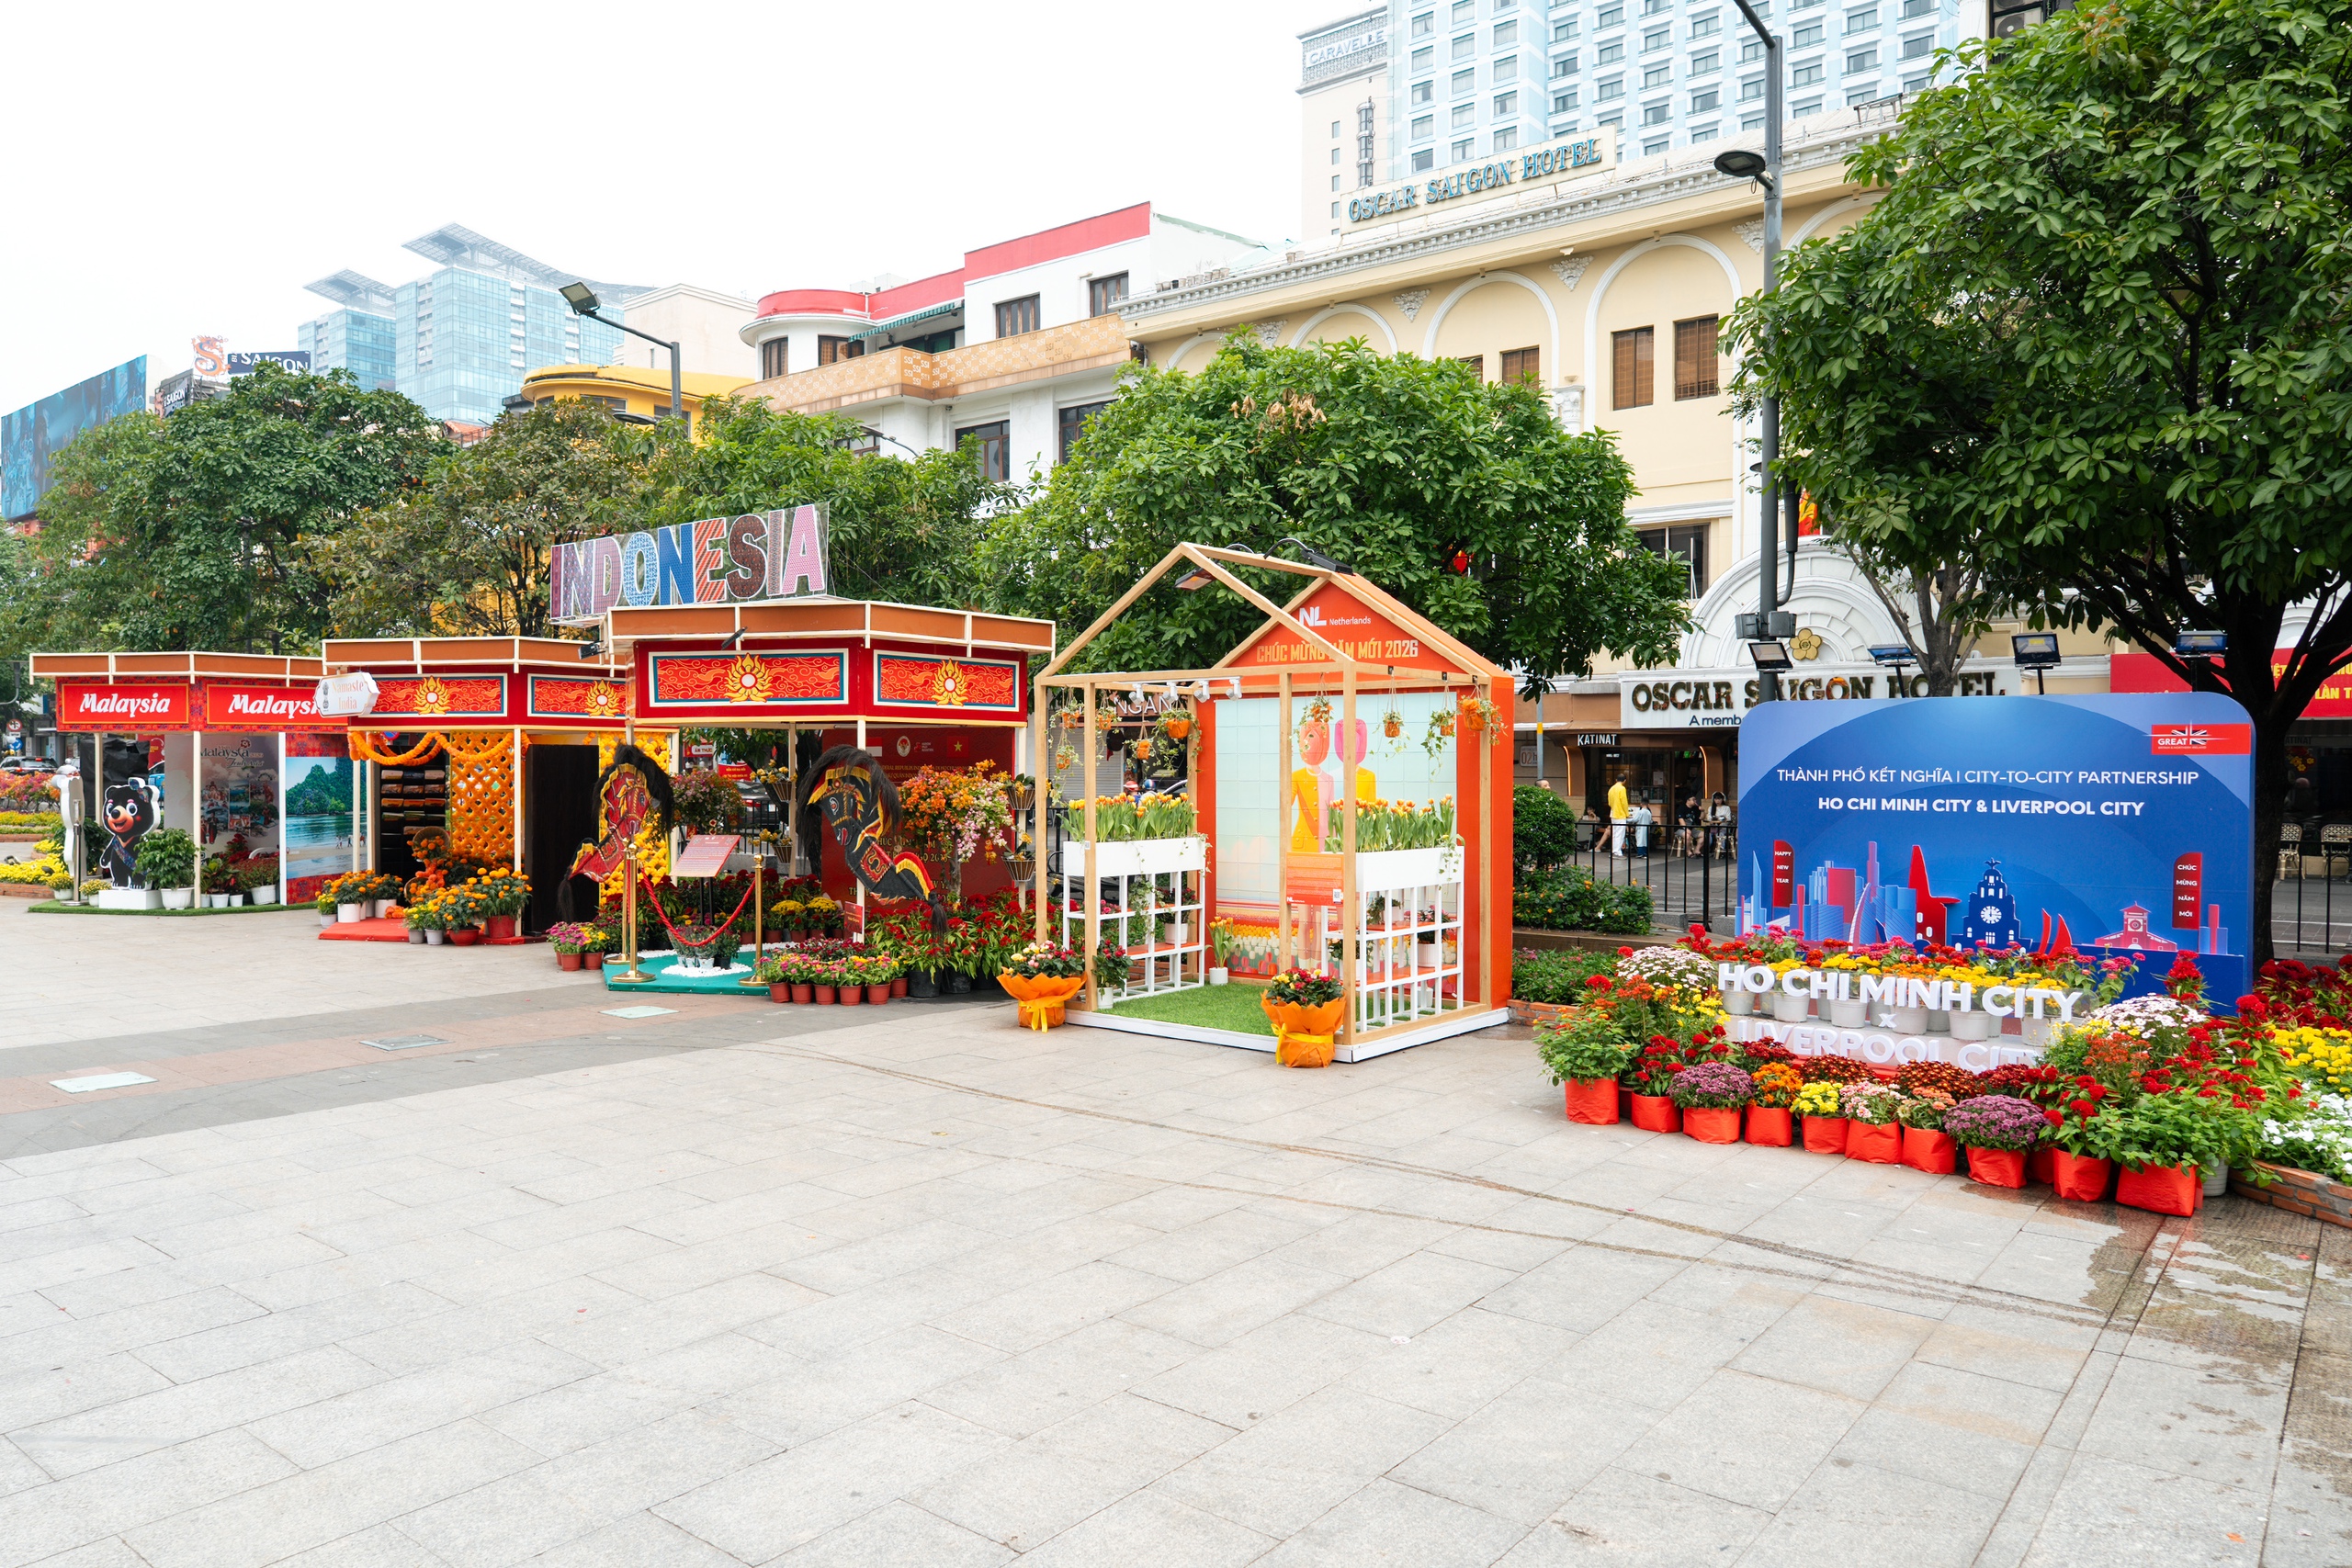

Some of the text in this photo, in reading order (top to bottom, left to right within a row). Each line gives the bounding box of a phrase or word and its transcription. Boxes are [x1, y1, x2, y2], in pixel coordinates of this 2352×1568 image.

[1309, 30, 1384, 64] CARAVELLE
[1349, 138, 1602, 222] OSCAR SAIGON HOTEL
[904, 355, 913, 365] SSI
[921, 359, 930, 368] SSI
[550, 503, 825, 619] INDONESIA
[1298, 605, 1372, 627] NL Netherlands
[1257, 642, 1288, 663] CHÚC
[1329, 639, 1354, 660] ĂM
[1357, 637, 1382, 659] MỚI
[1385, 639, 1419, 660] 2026
[333, 680, 364, 694] Namaste
[1632, 671, 2006, 712] OSCAR SIGON HOEL
[2314, 684, 2352, 700] LẦN T
[79, 693, 171, 718] Malaysia
[228, 694, 318, 719] Malaysi
[338, 696, 357, 710] India
[1689, 715, 1743, 726] A memb
[1577, 734, 1617, 747] KATINAT
[2157, 738, 2188, 746] GREAT
[2285, 737, 2312, 745] ATINAT
[1777, 767, 1828, 782] THÀNH
[1832, 766, 1866, 783] PHỐ
[1870, 766, 1896, 783] KẾT
[1901, 767, 1952, 784] NGHĨA
[2078, 771, 2199, 784] PARTNERSHIP
[1818, 797, 2145, 816] HO CHI MINH CITY & LIVERPOOL CITY
[1718, 963, 2083, 1022] HO CHI MINH CITY
